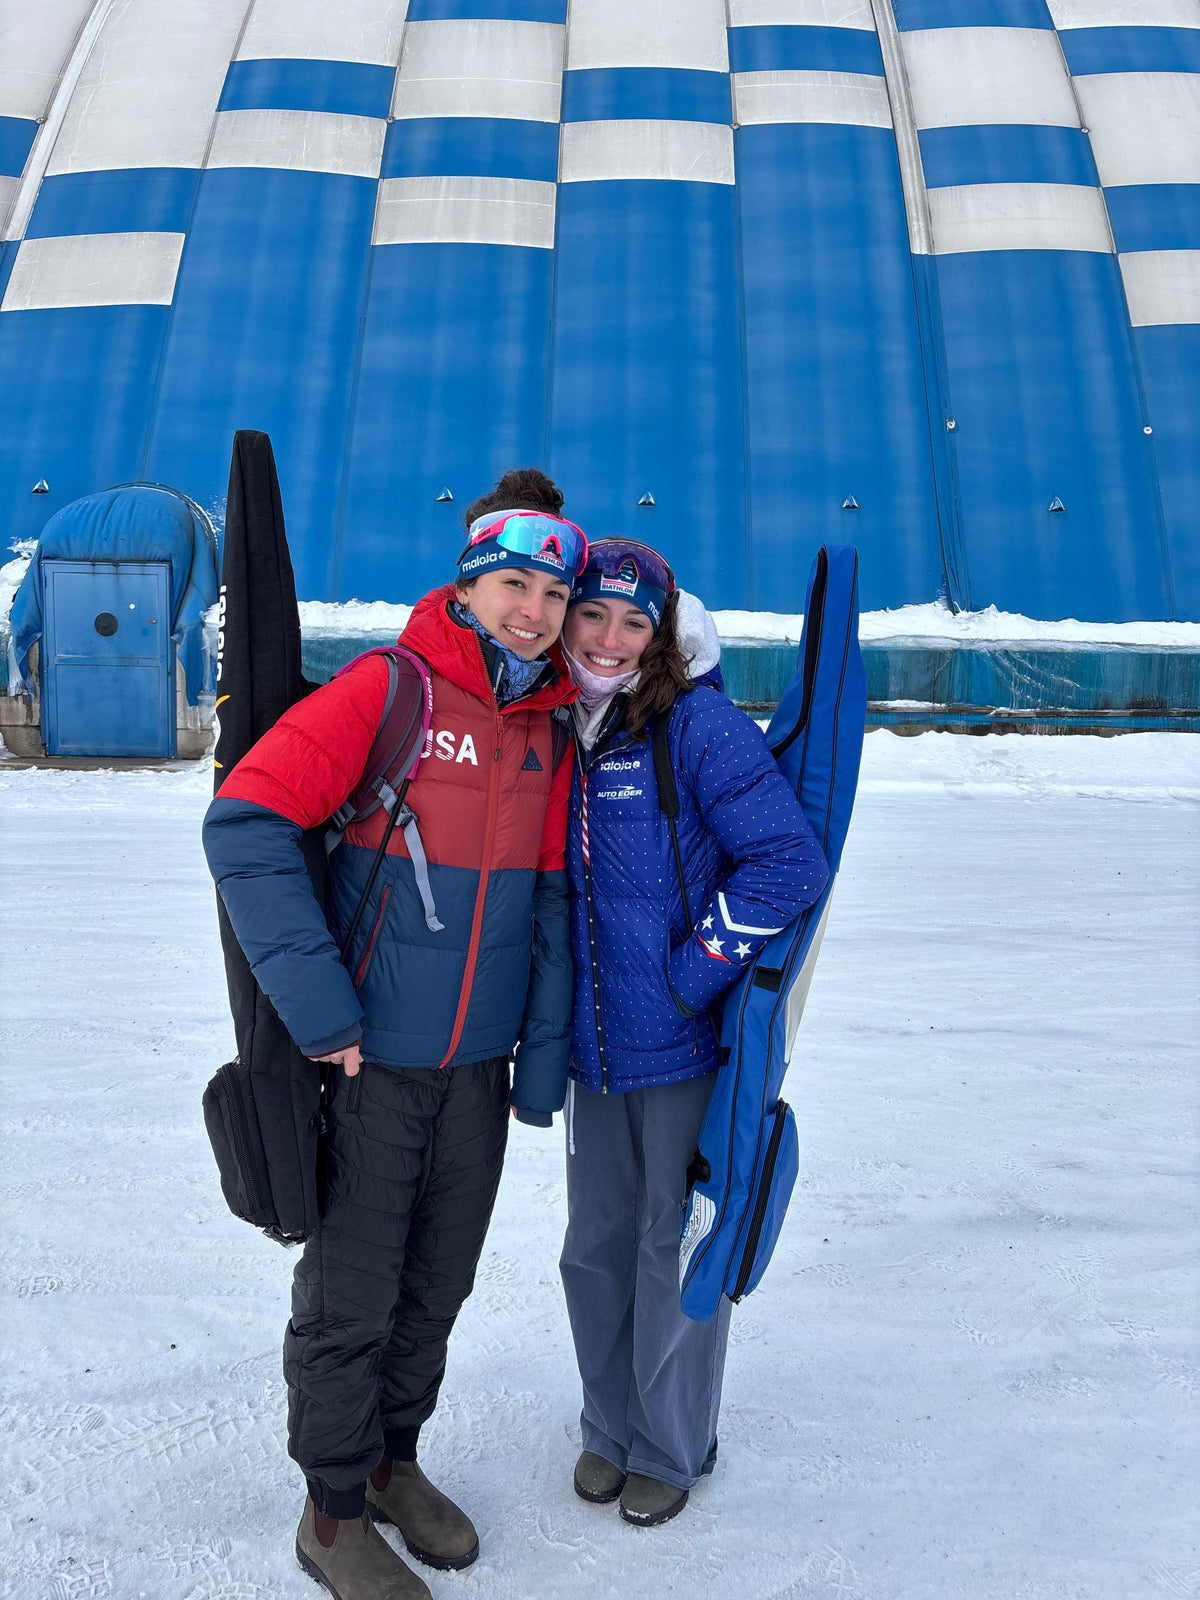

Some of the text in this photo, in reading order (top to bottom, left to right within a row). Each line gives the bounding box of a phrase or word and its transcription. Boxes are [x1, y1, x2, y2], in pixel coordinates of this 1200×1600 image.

[462, 552, 498, 573] maloja
[533, 555, 565, 569] BIATHLON
[602, 585, 634, 595] BIATHLON
[420, 729, 479, 766] USA
[618, 789, 643, 797] EDER
